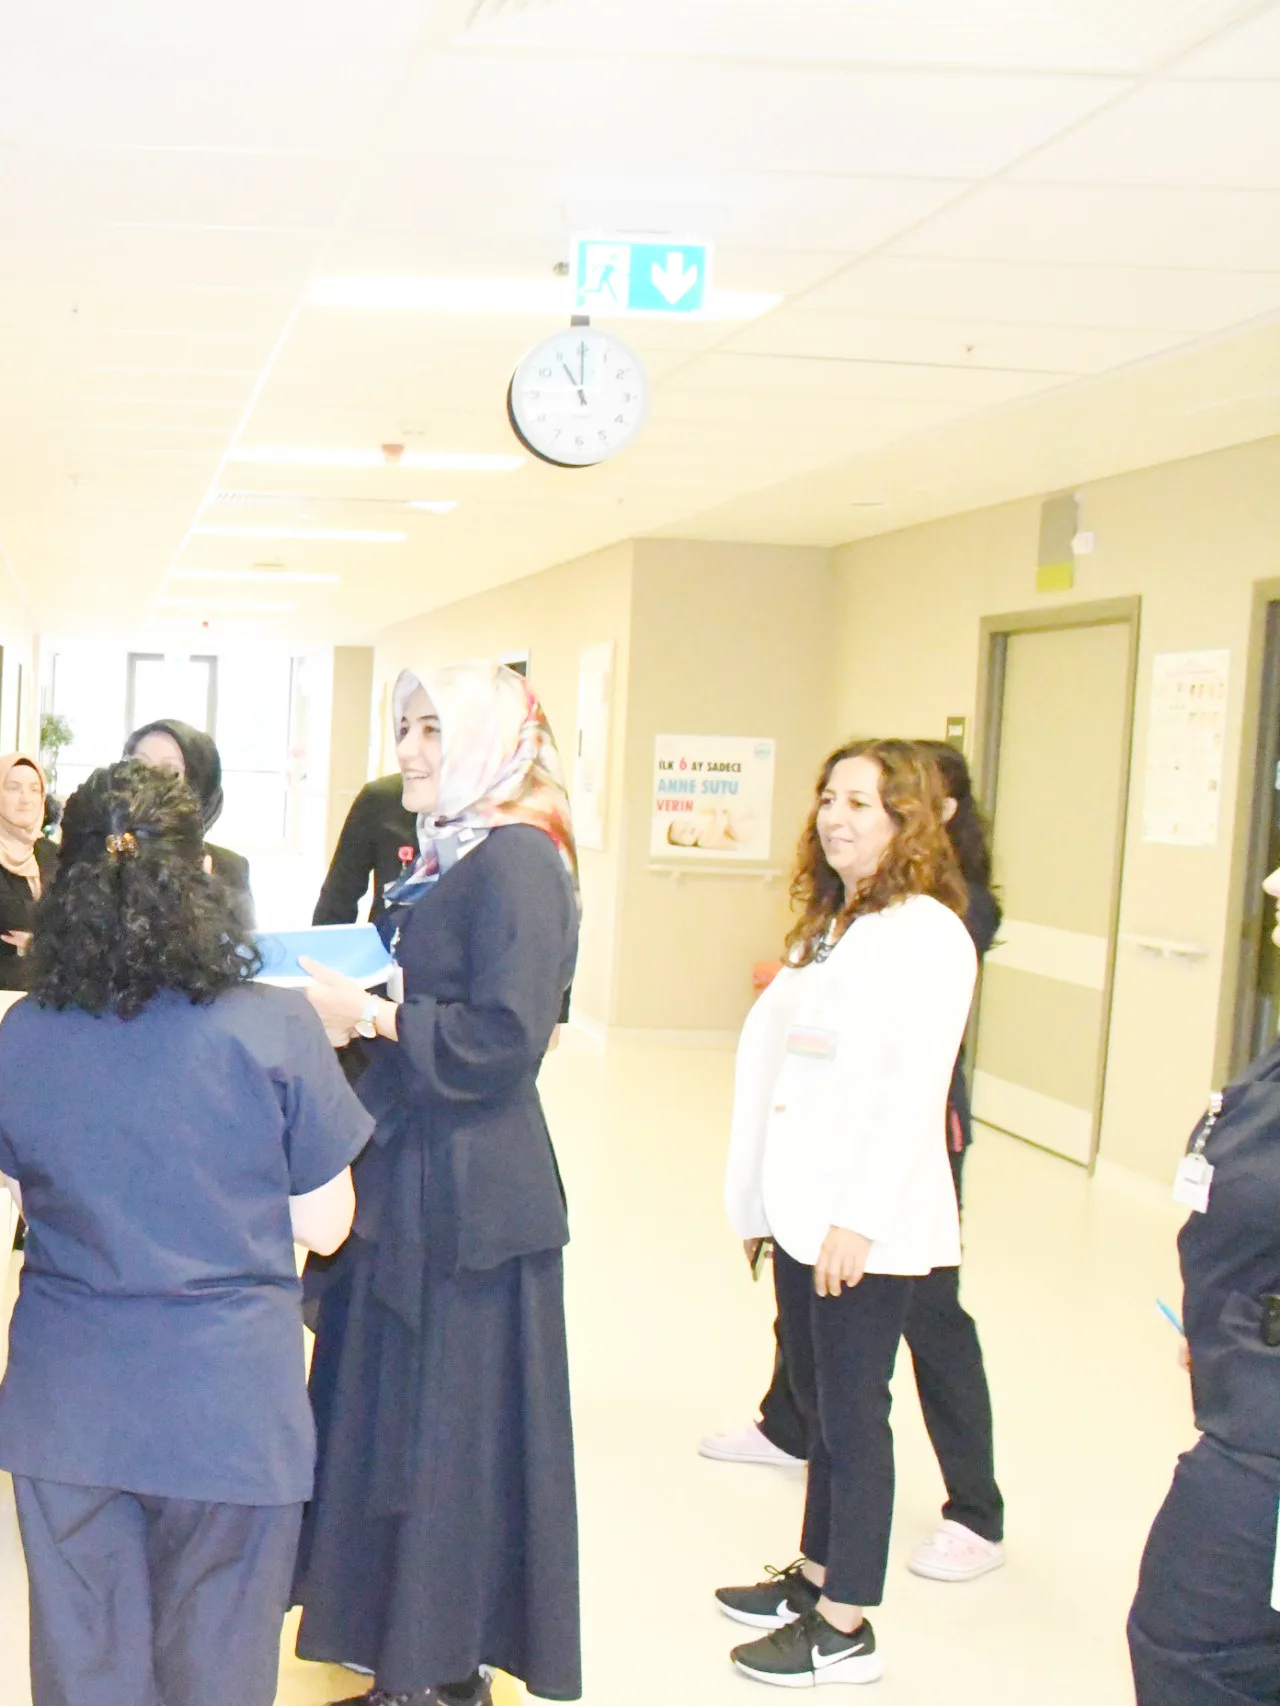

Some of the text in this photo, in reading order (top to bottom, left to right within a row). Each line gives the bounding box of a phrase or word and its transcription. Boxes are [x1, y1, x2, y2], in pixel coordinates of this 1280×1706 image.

[538, 367, 552, 378] 10
[614, 369, 626, 380] 2
[622, 392, 631, 403] 3
[614, 414, 624, 424] 4
[554, 429, 562, 439] 7
[597, 430, 607, 441] 5
[574, 436, 584, 447] 6
[679, 755, 688, 771] 6
[691, 761, 704, 772] AY
[707, 761, 742, 773] SADECE
[658, 778, 697, 794] ANNE
